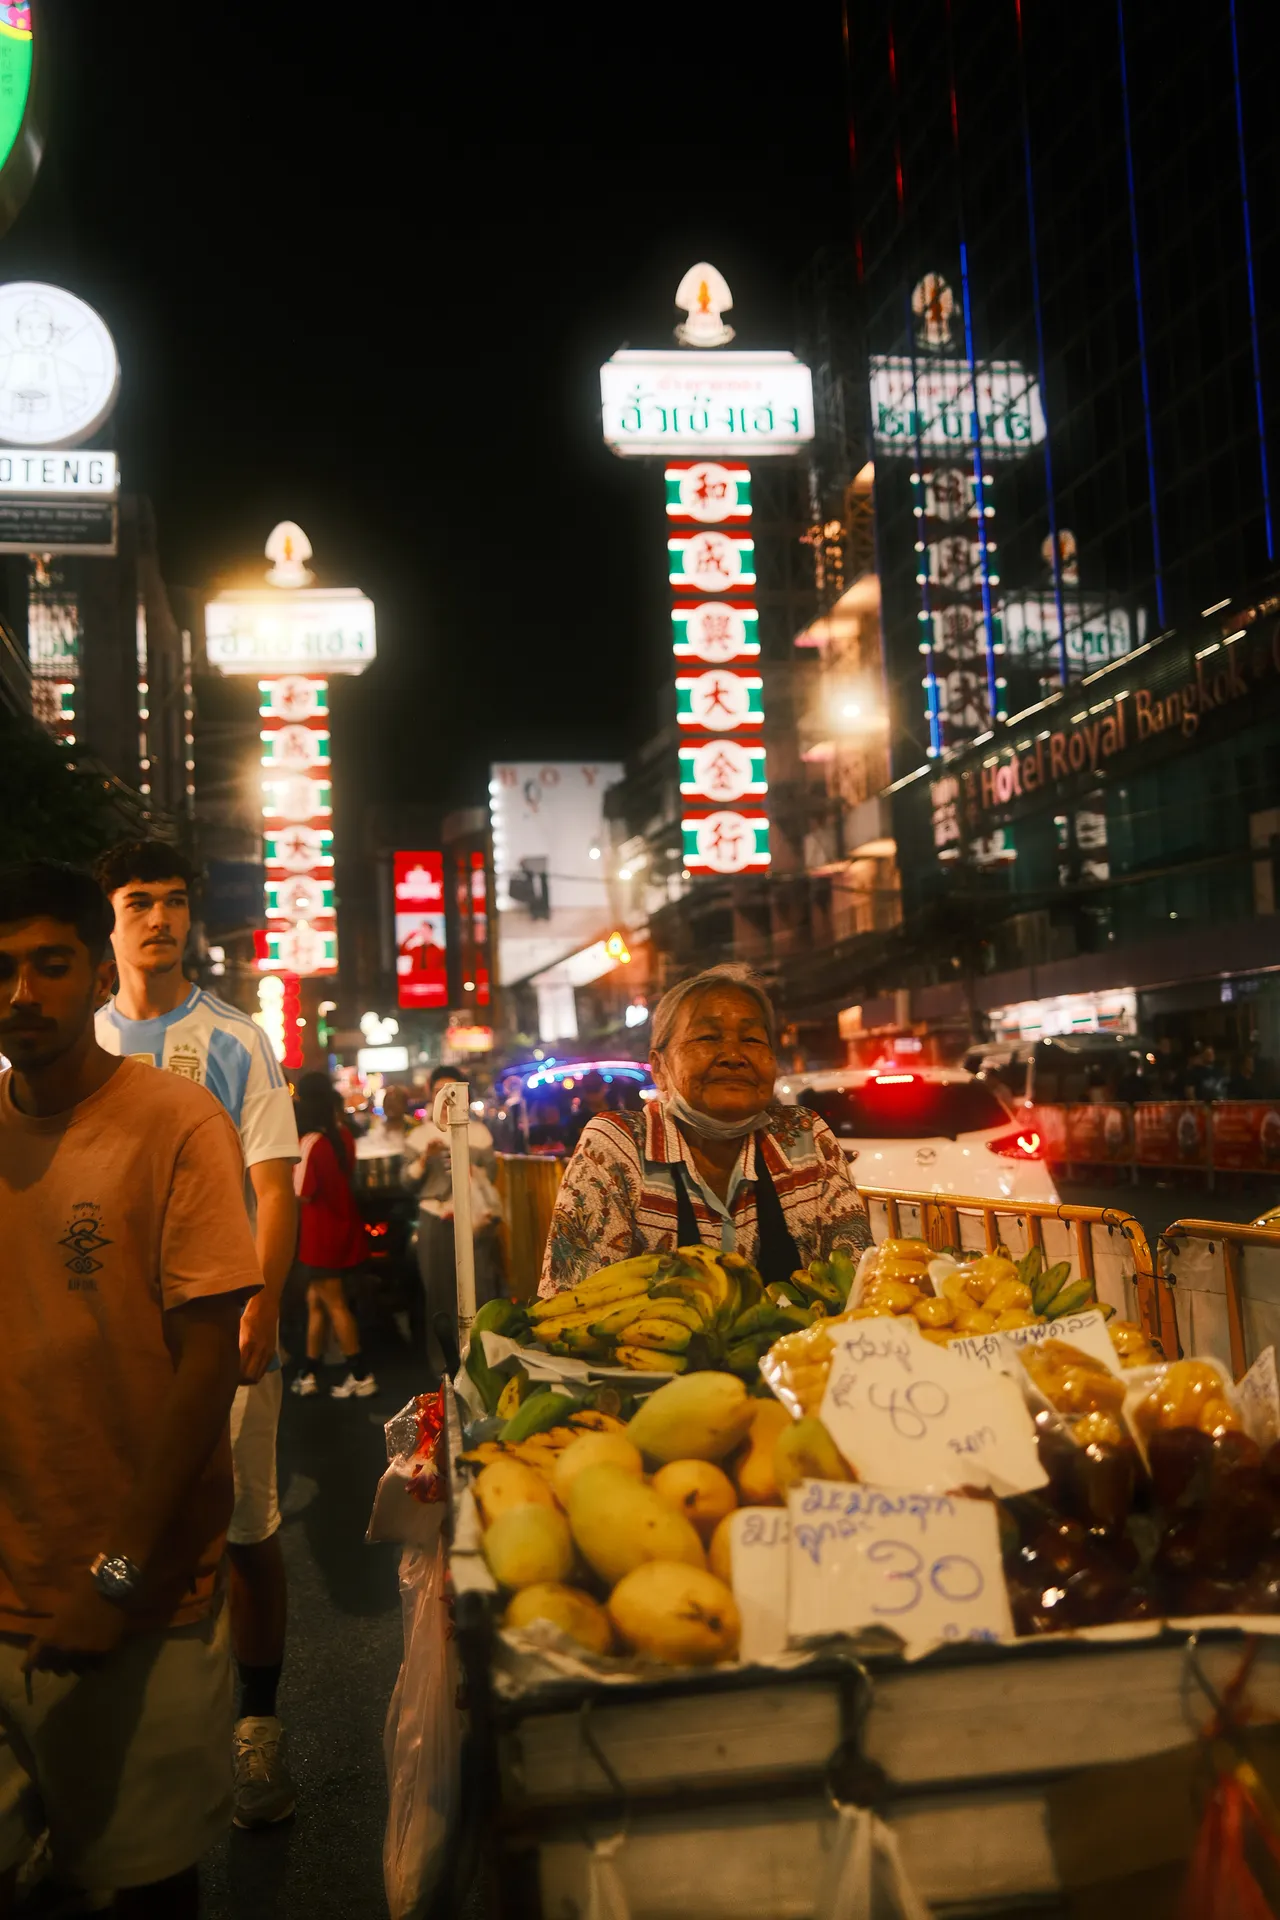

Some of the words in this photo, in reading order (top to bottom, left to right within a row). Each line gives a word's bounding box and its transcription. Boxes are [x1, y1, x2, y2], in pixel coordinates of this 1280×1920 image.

[981, 742, 1043, 809] Hotel
[1050, 699, 1127, 779] Royal
[1134, 646, 1248, 741] Bangkok
[867, 1538, 985, 1616] 30
